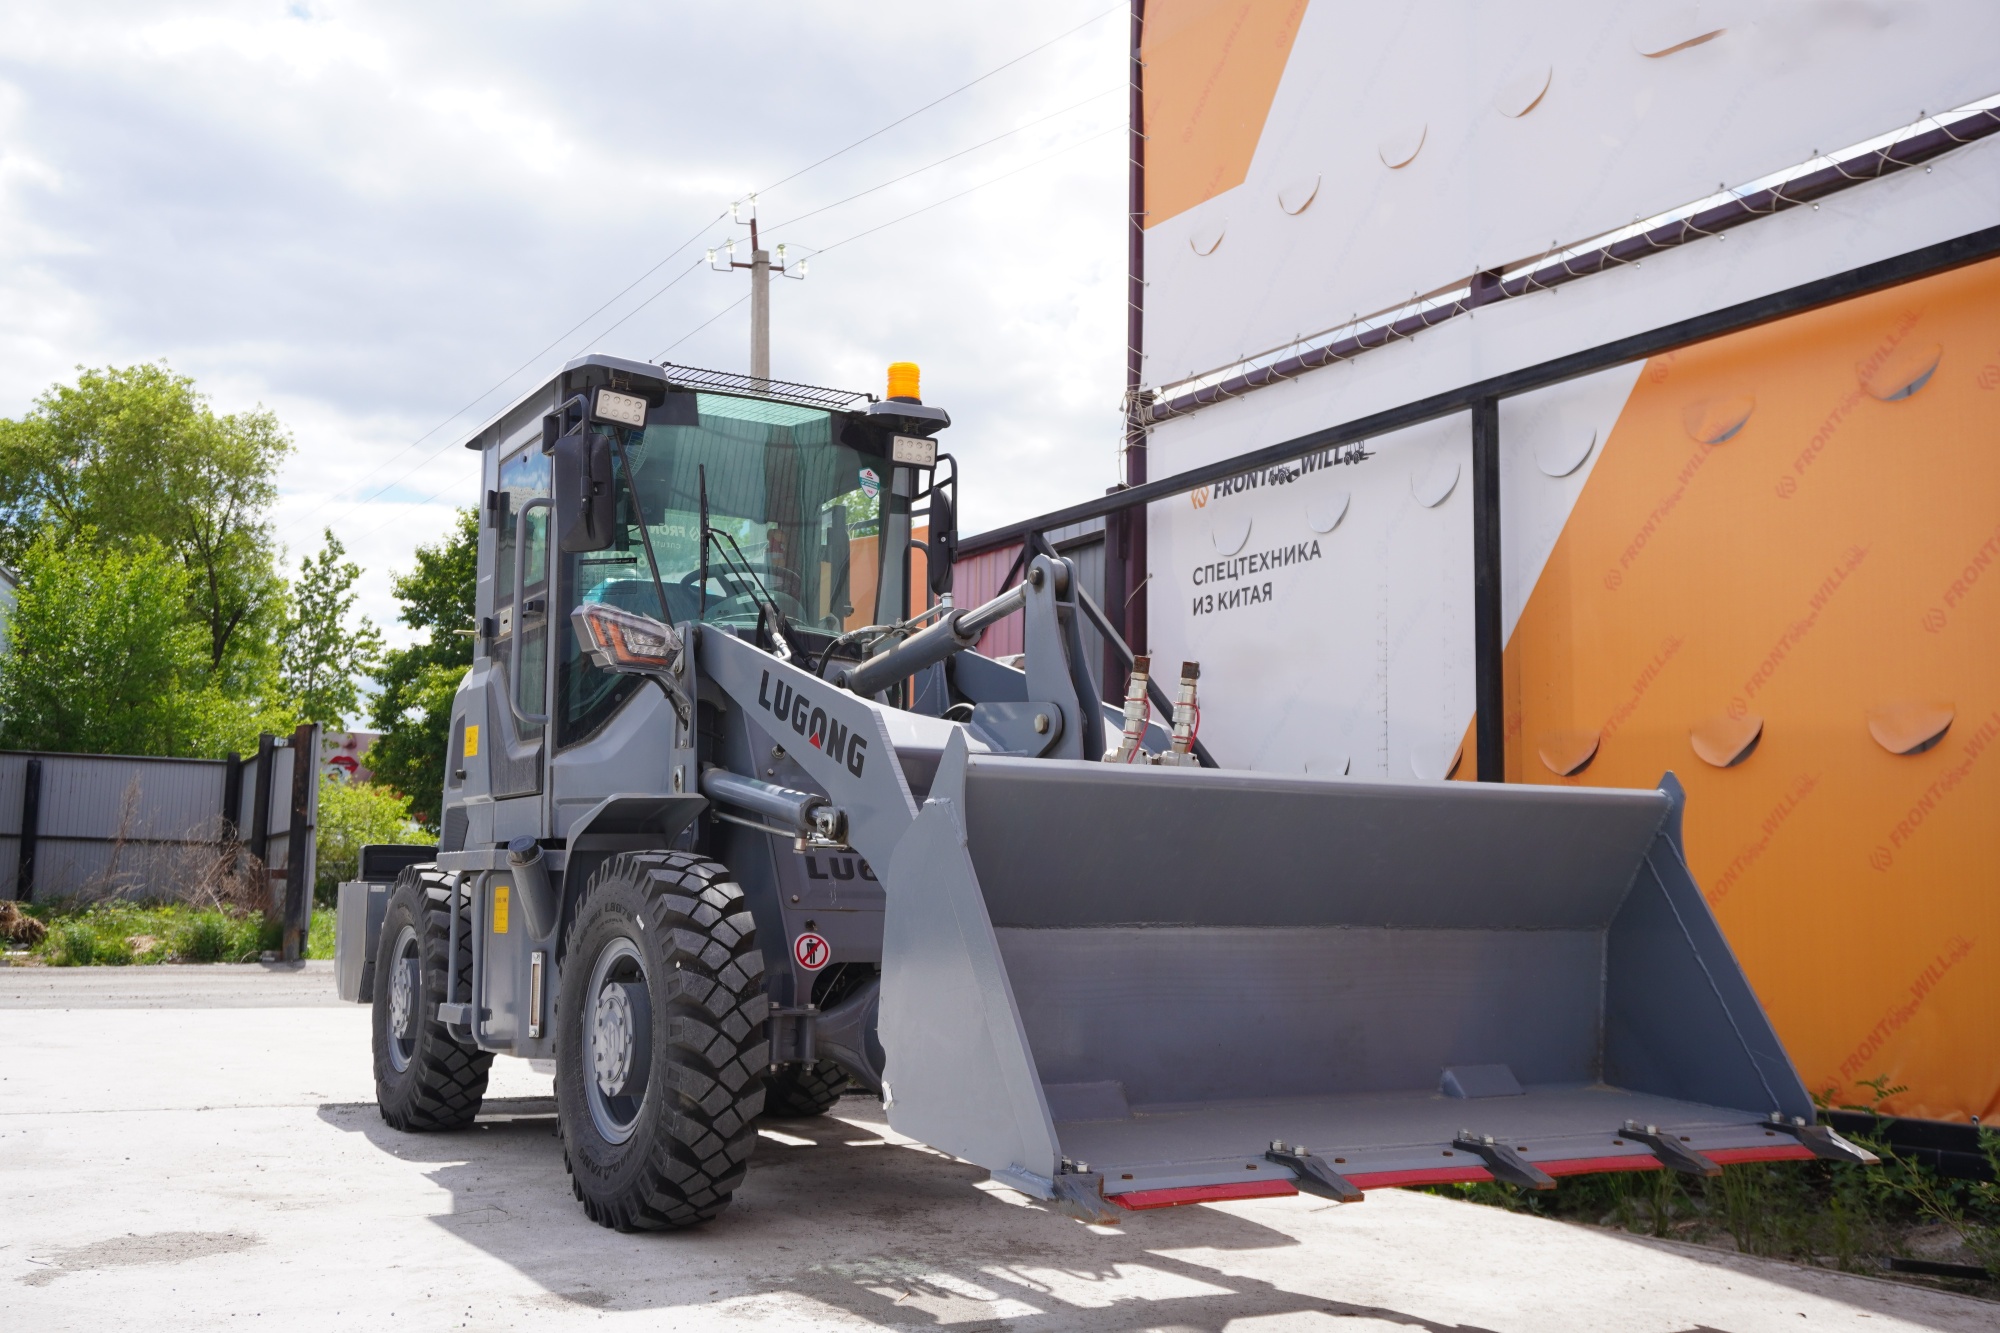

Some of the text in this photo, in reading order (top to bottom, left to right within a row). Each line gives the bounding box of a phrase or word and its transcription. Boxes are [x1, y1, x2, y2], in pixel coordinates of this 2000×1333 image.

[1794, 334, 1901, 475] FRONT WILL
[1213, 447, 1344, 499] FRONT WILL
[1193, 540, 1322, 586] СПЕЦТЕХНИКА
[1620, 508, 1662, 569] FRONT
[1193, 582, 1273, 616] ИЗ КИТАЯ
[1943, 536, 1999, 609] FRONT
[1745, 566, 1848, 699] FRONT WILL
[1632, 654, 1666, 695] WILL
[758, 669, 868, 779] LUGONG
[1889, 782, 1942, 849] FRONT
[805, 856, 878, 881] LUG
[1705, 792, 1799, 909] RONT WILL
[1840, 954, 1952, 1081] FRONT WILL
